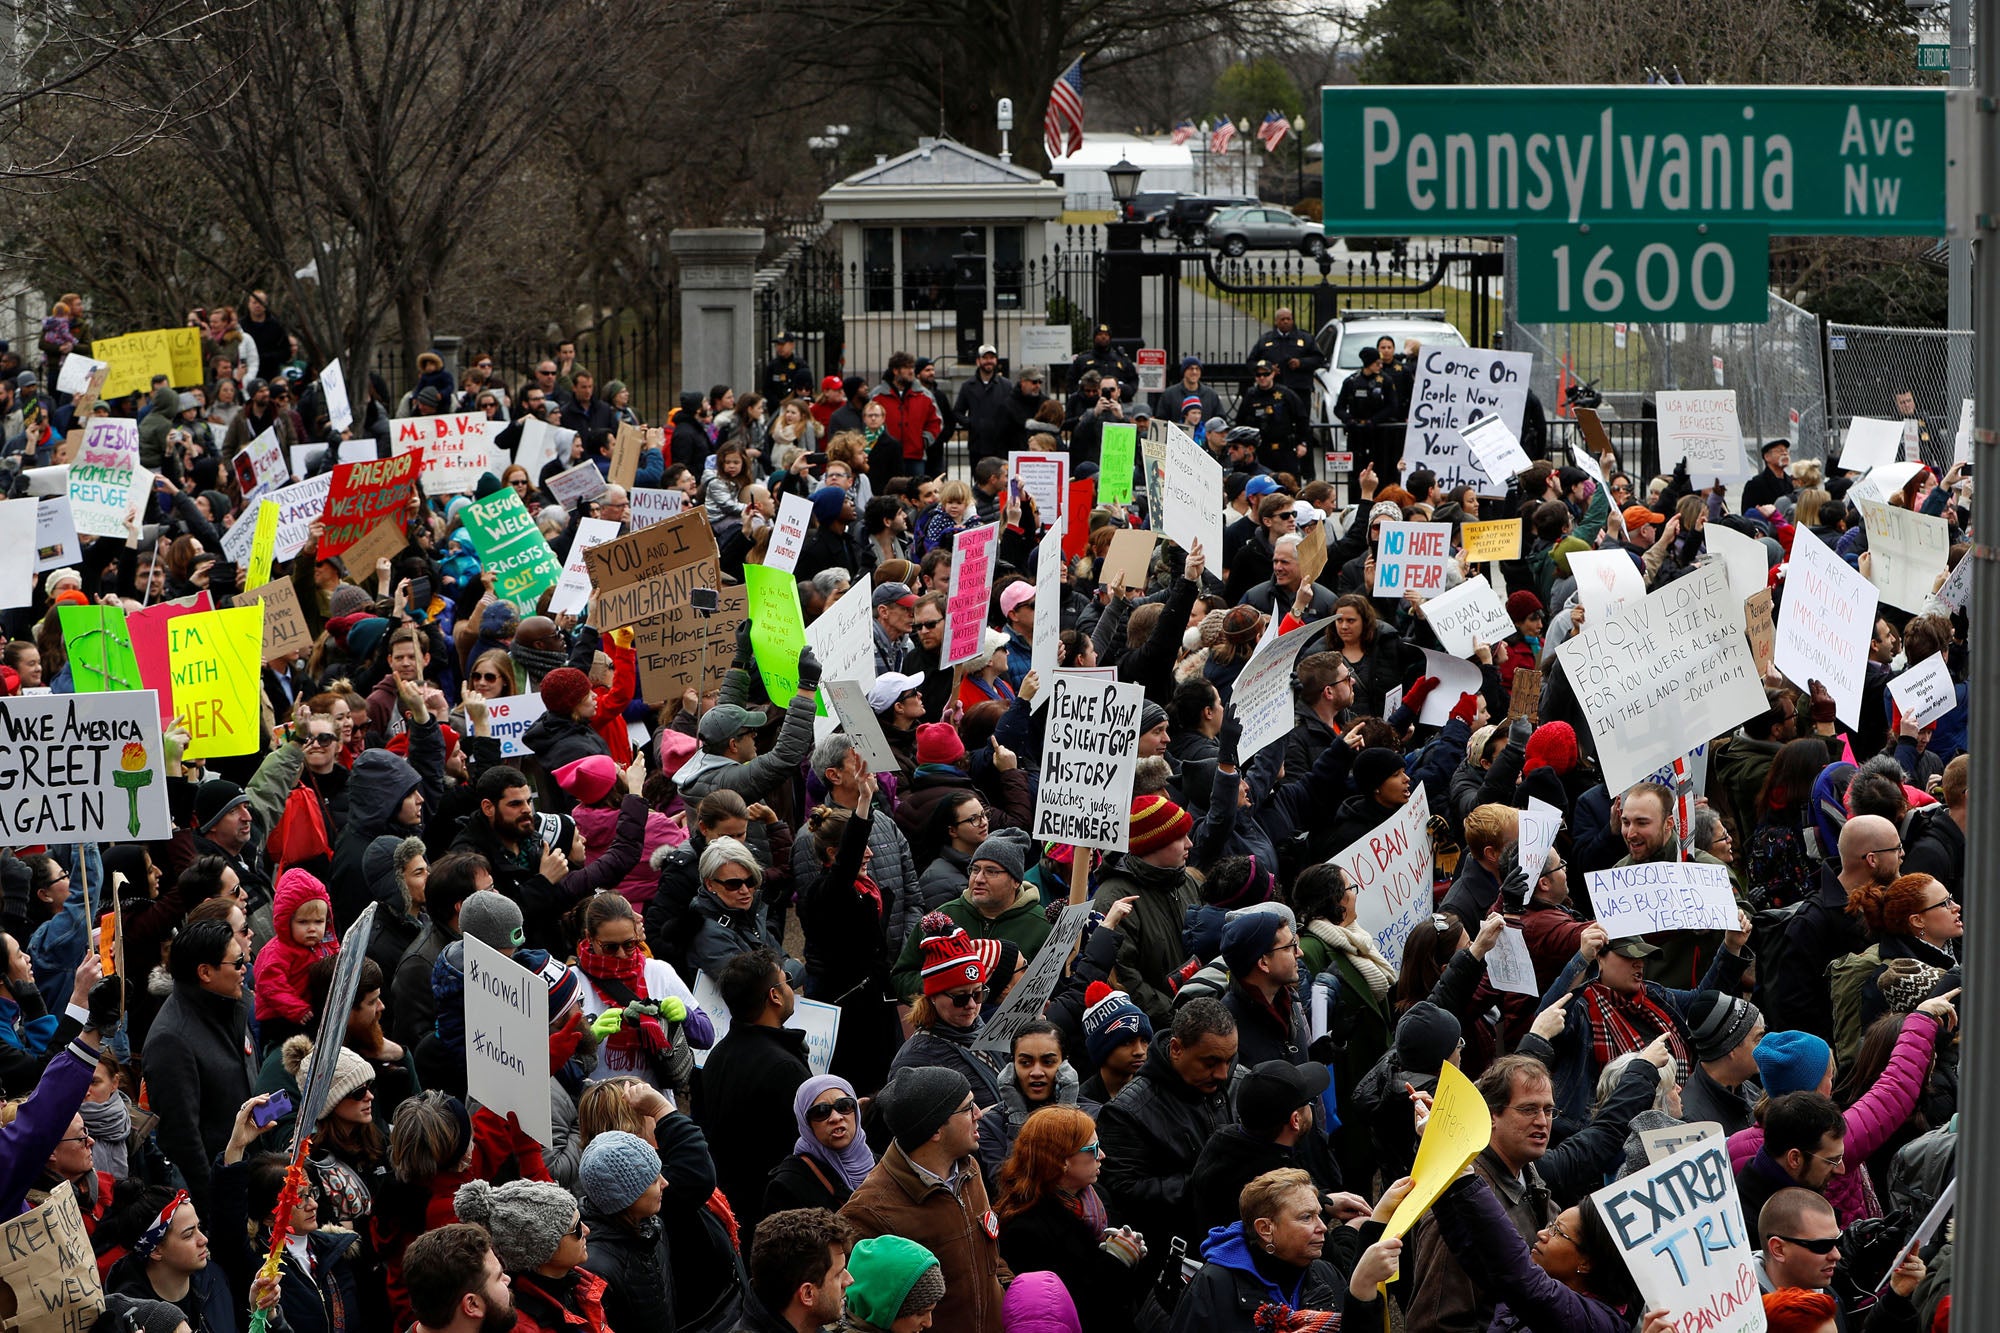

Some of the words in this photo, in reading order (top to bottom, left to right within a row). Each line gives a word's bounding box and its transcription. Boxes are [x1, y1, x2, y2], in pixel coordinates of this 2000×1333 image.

[1839, 105, 1915, 158] Ave
[1363, 107, 1795, 224] Pennsylvania
[1844, 163, 1901, 216] Nw
[1552, 242, 1736, 313] 1600
[98, 334, 165, 356] AMERICA
[1425, 351, 1480, 380] Come
[1490, 360, 1517, 384] On
[1420, 378, 1457, 404] People
[1414, 403, 1459, 429] Smile
[1666, 401, 1682, 413] USA
[1423, 432, 1459, 456] Your
[1682, 438, 1718, 451] DEPORT
[346, 454, 412, 490] AMERICA
[633, 492, 652, 508] NO
[654, 493, 680, 511] BAN
[646, 542, 669, 563] AND
[667, 524, 690, 555] I
[965, 546, 985, 560] CAME
[1384, 531, 1405, 556] NO
[1408, 532, 1445, 557] HATE
[487, 544, 541, 574] RACISTS
[534, 561, 551, 575] OF
[597, 539, 643, 577] YOU
[635, 562, 666, 583] WERE
[960, 563, 973, 576] FOR
[503, 568, 533, 591] OUT
[1379, 564, 1400, 588] NO
[1404, 564, 1443, 589] FEAR
[1804, 544, 1818, 565] WE
[1824, 563, 1847, 587] ARE
[1850, 587, 1860, 604] A
[600, 561, 709, 628] IMMIGRANTS
[1605, 598, 1625, 617] NOT
[1804, 570, 1853, 624] NATION
[1436, 616, 1455, 635] NO
[1454, 600, 1480, 625] BAN
[1463, 619, 1481, 636] NO
[1566, 604, 1650, 672] SHOW
[1660, 572, 1723, 617] LOVE
[637, 632, 659, 645] THE
[953, 624, 979, 642] MOTHER
[172, 658, 218, 686] WITH
[671, 671, 694, 686] TO
[702, 664, 726, 682] ME
[1575, 655, 1620, 693] FOR
[1621, 631, 1658, 664] THE
[1583, 685, 1617, 715] FOR
[1617, 672, 1643, 694] YOU
[1649, 648, 1688, 681] WERE
[1692, 622, 1738, 652] ALIENS
[1904, 670, 1937, 694] Immigration
[1916, 684, 1934, 697] Rights
[1596, 715, 1616, 737] IN
[1617, 700, 1645, 725] THE
[1649, 679, 1680, 709] LAND
[1684, 665, 1698, 683] OF
[1925, 695, 1934, 703] are
[1932, 695, 1948, 708] Rights
[61, 699, 143, 742] AMERICA
[176, 699, 233, 740] HER
[1051, 722, 1060, 743] &
[1062, 722, 1109, 755] SILENT
[1045, 752, 1118, 791] HISTORY
[1038, 810, 1120, 844] REMEMBERS
[1369, 820, 1410, 873] BAN
[1412, 871, 1441, 916] NO
[1594, 871, 1609, 894] A
[1611, 864, 1679, 891] MOSQUE
[1684, 865, 1698, 885] IN
[1697, 865, 1732, 889] TEXAS
[1596, 896, 1633, 919] WAS
[1633, 888, 1706, 912] BURNED
[1648, 904, 1730, 932] YESTERDAY
[470, 959, 531, 1018] #nowall
[1084, 996, 1131, 1036] PATRIOTS
[472, 1026, 526, 1076] #noban
